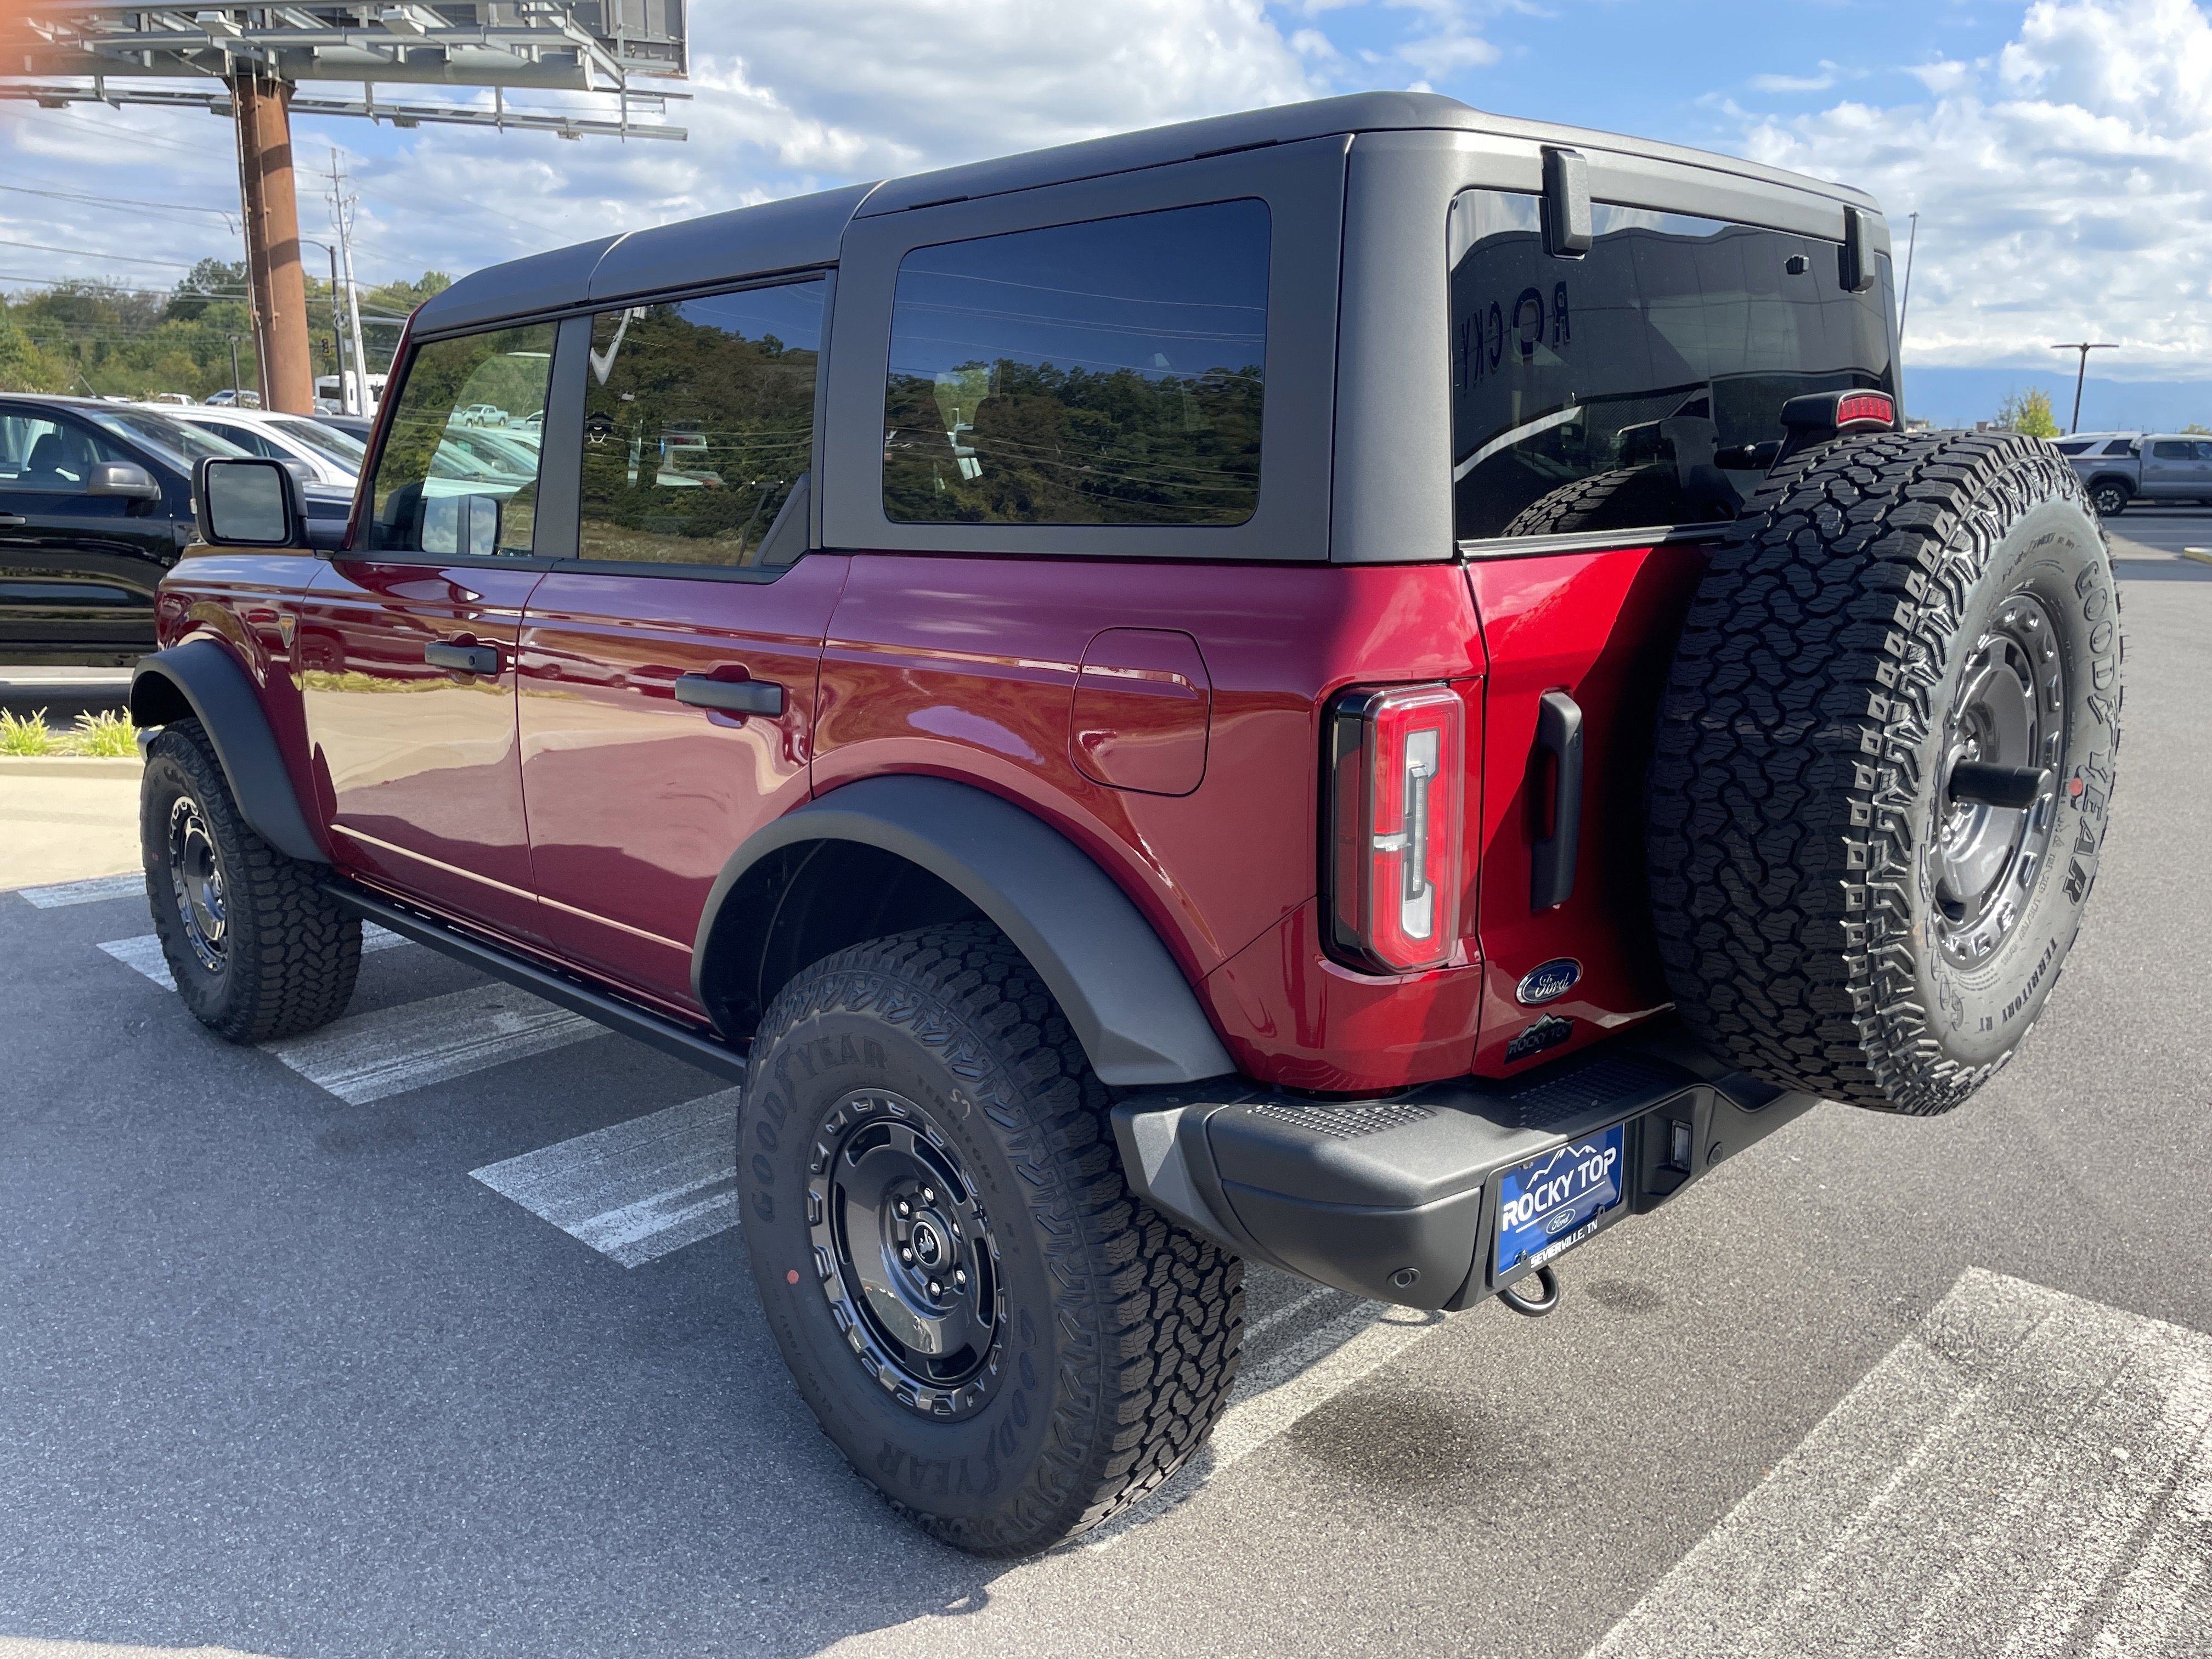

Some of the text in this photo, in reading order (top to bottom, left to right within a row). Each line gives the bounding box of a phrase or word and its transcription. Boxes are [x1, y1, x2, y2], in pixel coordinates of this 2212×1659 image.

[1534, 972, 1569, 998] Ford
[2001, 936, 2058, 1025] TERRITORY
[1508, 1025, 1567, 1054] ROCKY TO
[1503, 1147, 1617, 1232] ROCKY TOP
[1551, 1212, 1570, 1231] Ford
[1587, 1218, 1598, 1233] TN
